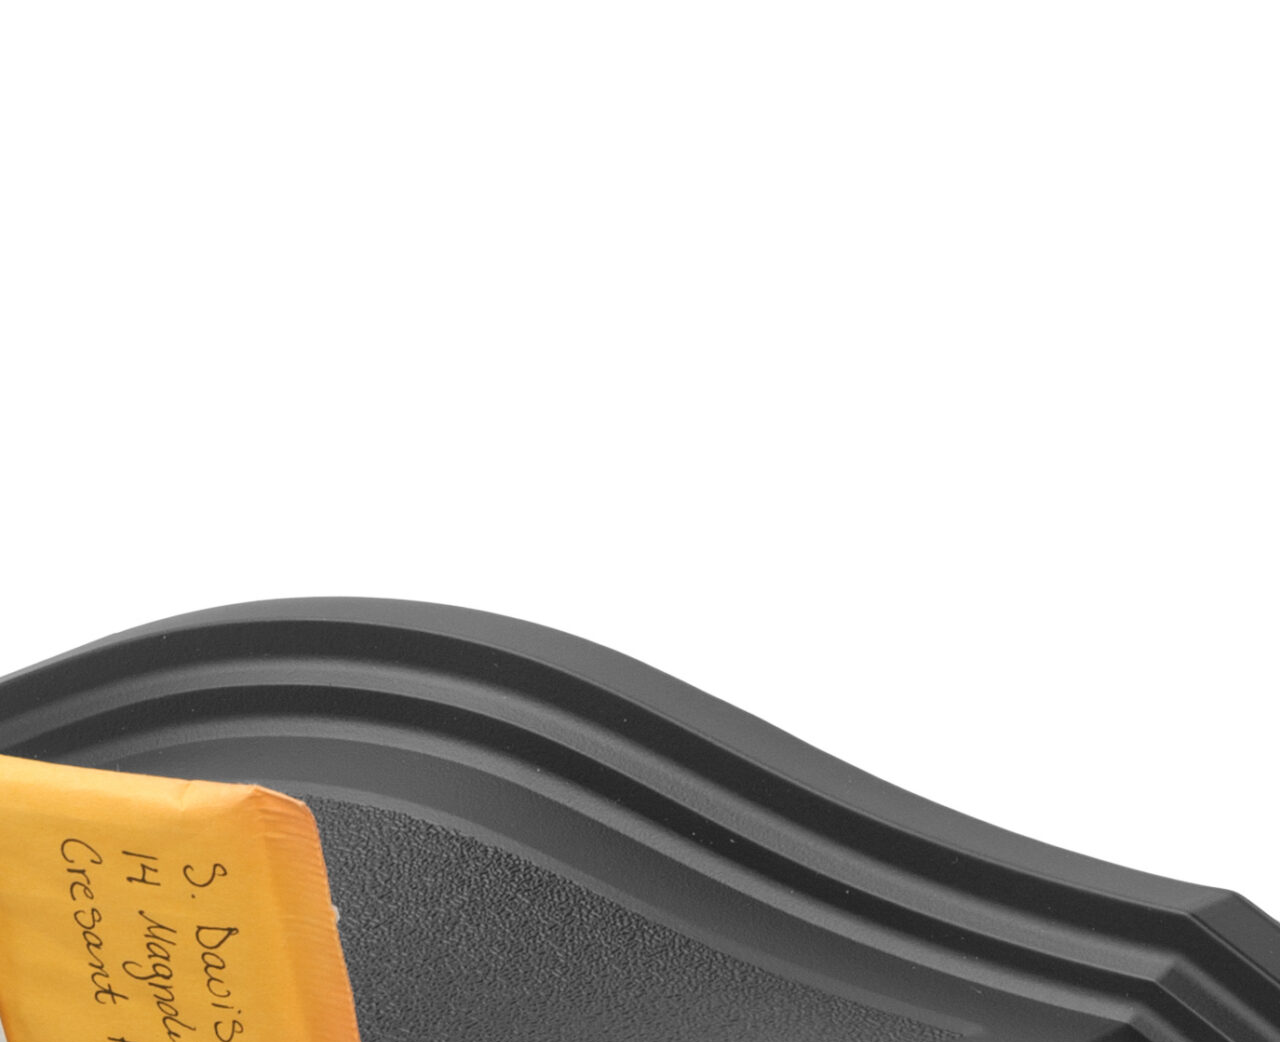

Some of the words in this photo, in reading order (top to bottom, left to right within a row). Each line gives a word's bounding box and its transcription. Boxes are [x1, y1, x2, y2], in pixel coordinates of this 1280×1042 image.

[122, 850, 162, 888] 14
[183, 864, 228, 899] S.
[61, 838, 128, 1005] Cresant
